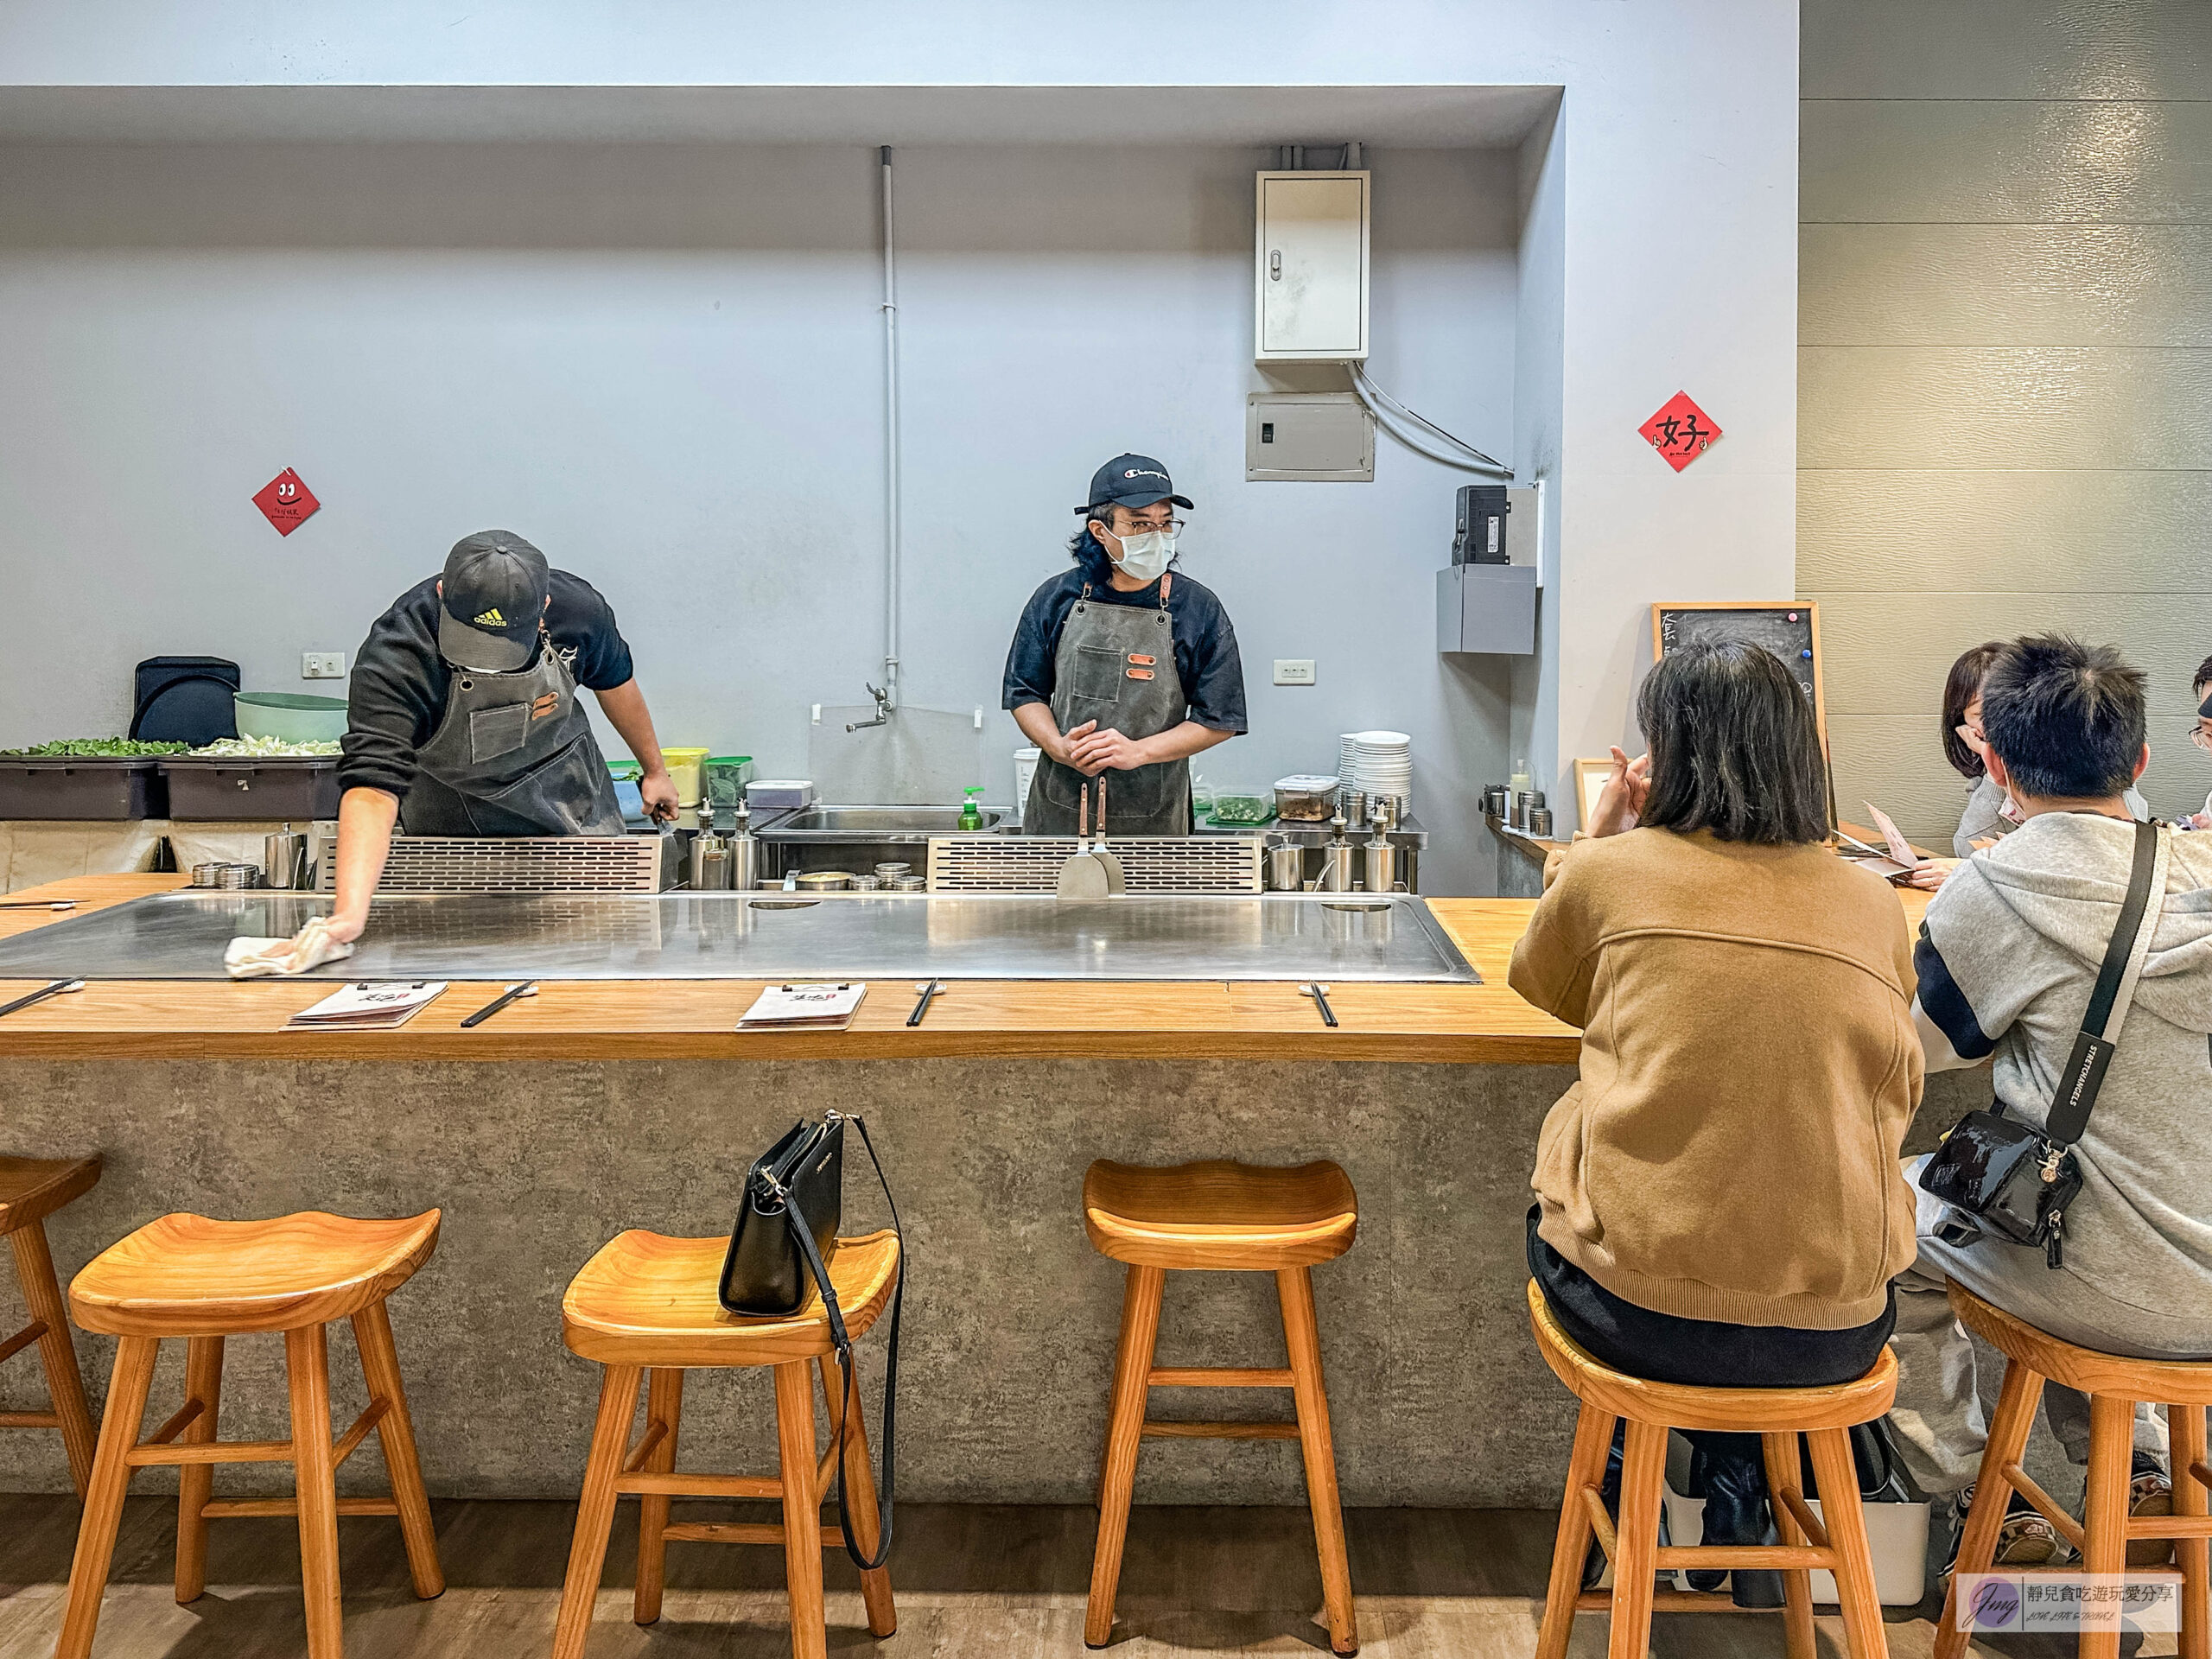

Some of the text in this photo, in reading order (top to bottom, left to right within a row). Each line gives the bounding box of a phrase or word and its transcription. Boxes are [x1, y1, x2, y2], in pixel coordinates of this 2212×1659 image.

[1656, 415, 1709, 452] 好
[474, 616, 507, 627] adidas
[2069, 1044, 2098, 1107] STRETCHANGELS
